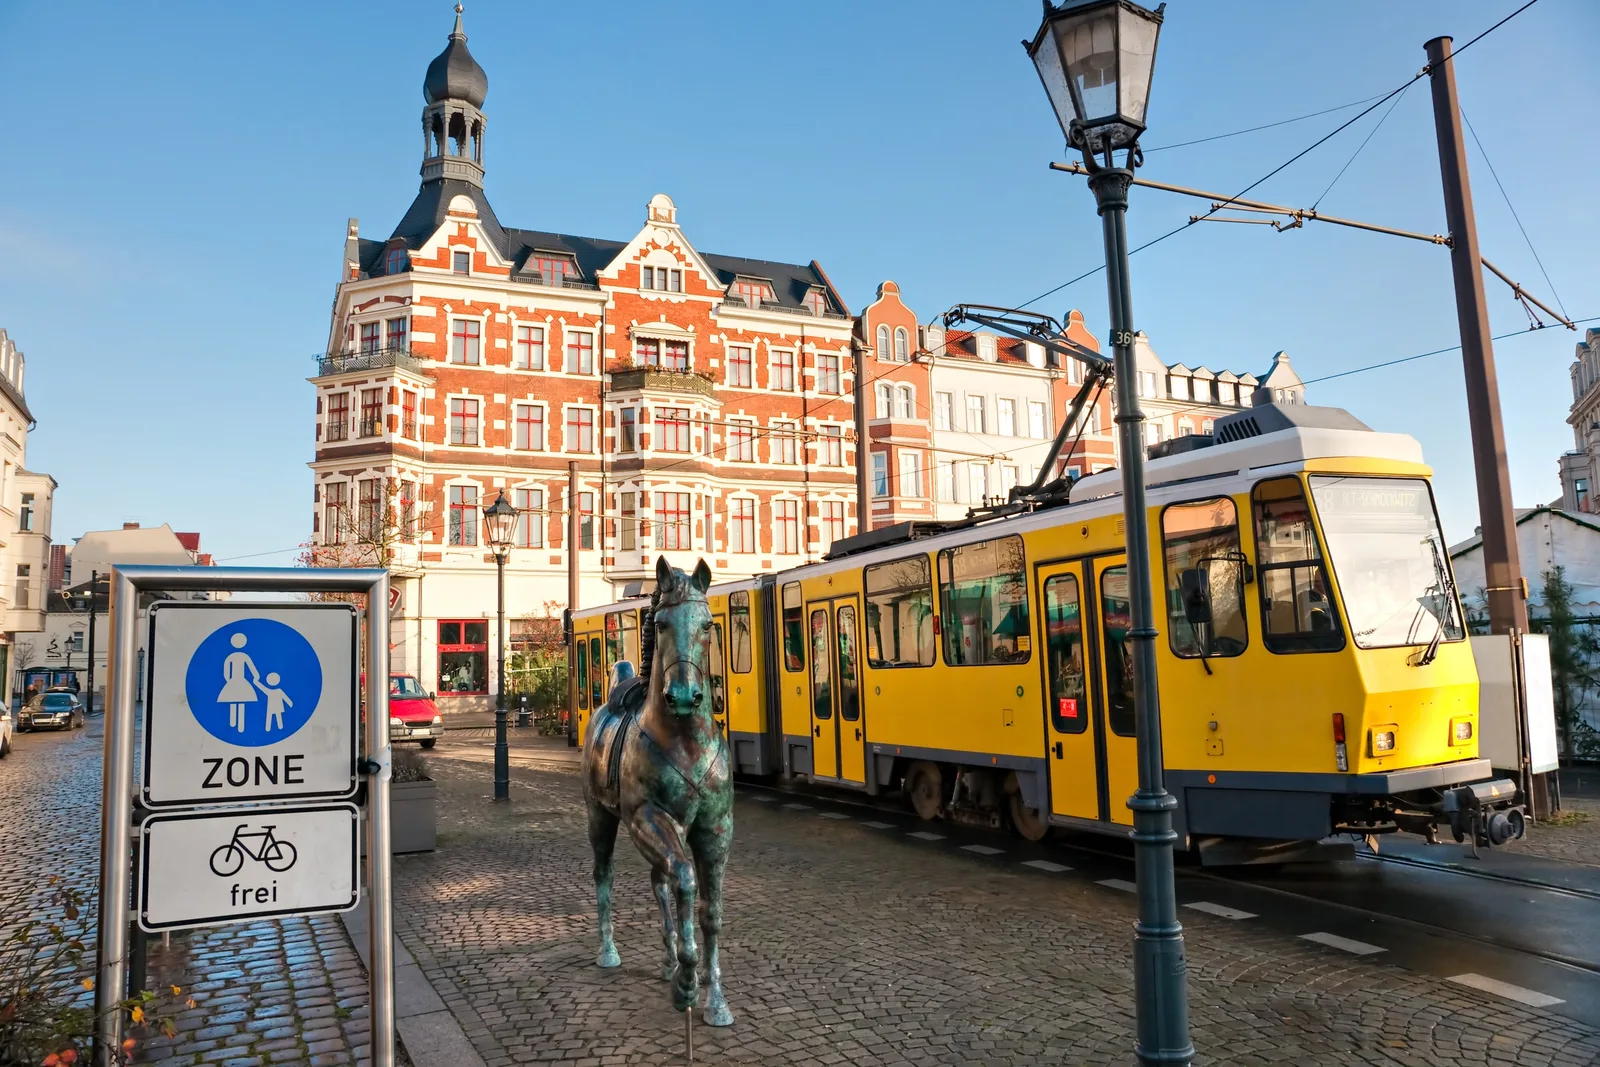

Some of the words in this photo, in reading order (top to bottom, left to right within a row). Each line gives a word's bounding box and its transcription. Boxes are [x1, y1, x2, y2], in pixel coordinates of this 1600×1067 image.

[1116, 331, 1131, 345] 36
[202, 754, 304, 788] ZONE
[231, 880, 277, 906] frei
